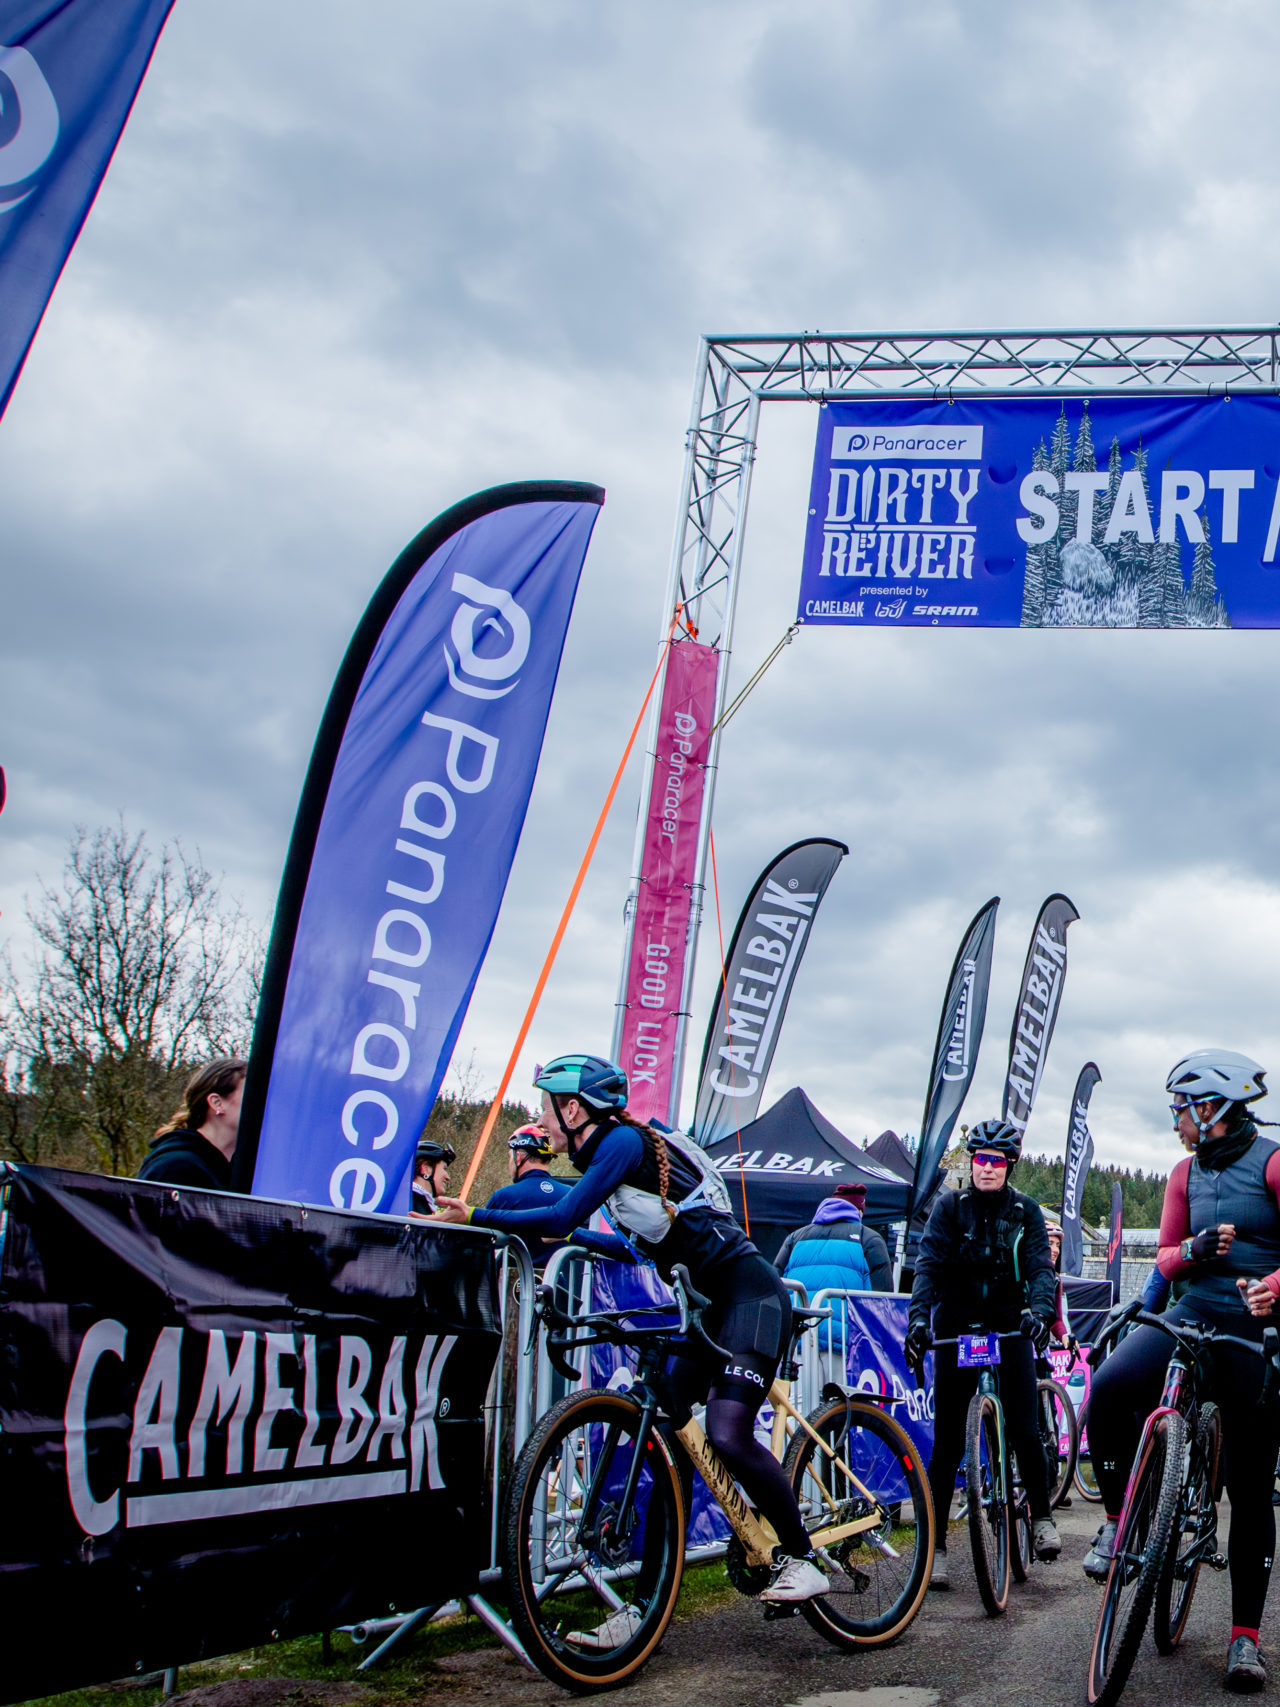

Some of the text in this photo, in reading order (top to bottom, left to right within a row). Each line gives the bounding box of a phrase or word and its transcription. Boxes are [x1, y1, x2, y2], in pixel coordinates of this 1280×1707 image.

[873, 435, 967, 451] Panaracer
[824, 465, 981, 524] DIRTY
[819, 531, 976, 579] REIVER
[806, 600, 864, 618] CAMELBAK
[912, 606, 978, 617] SRAM
[860, 586, 928, 597] presented by
[662, 737, 692, 844] Panaracer
[329, 711, 500, 1212] Panarace
[630, 943, 671, 1086] GOOD LUCK
[724, 1364, 765, 1388] LE COL
